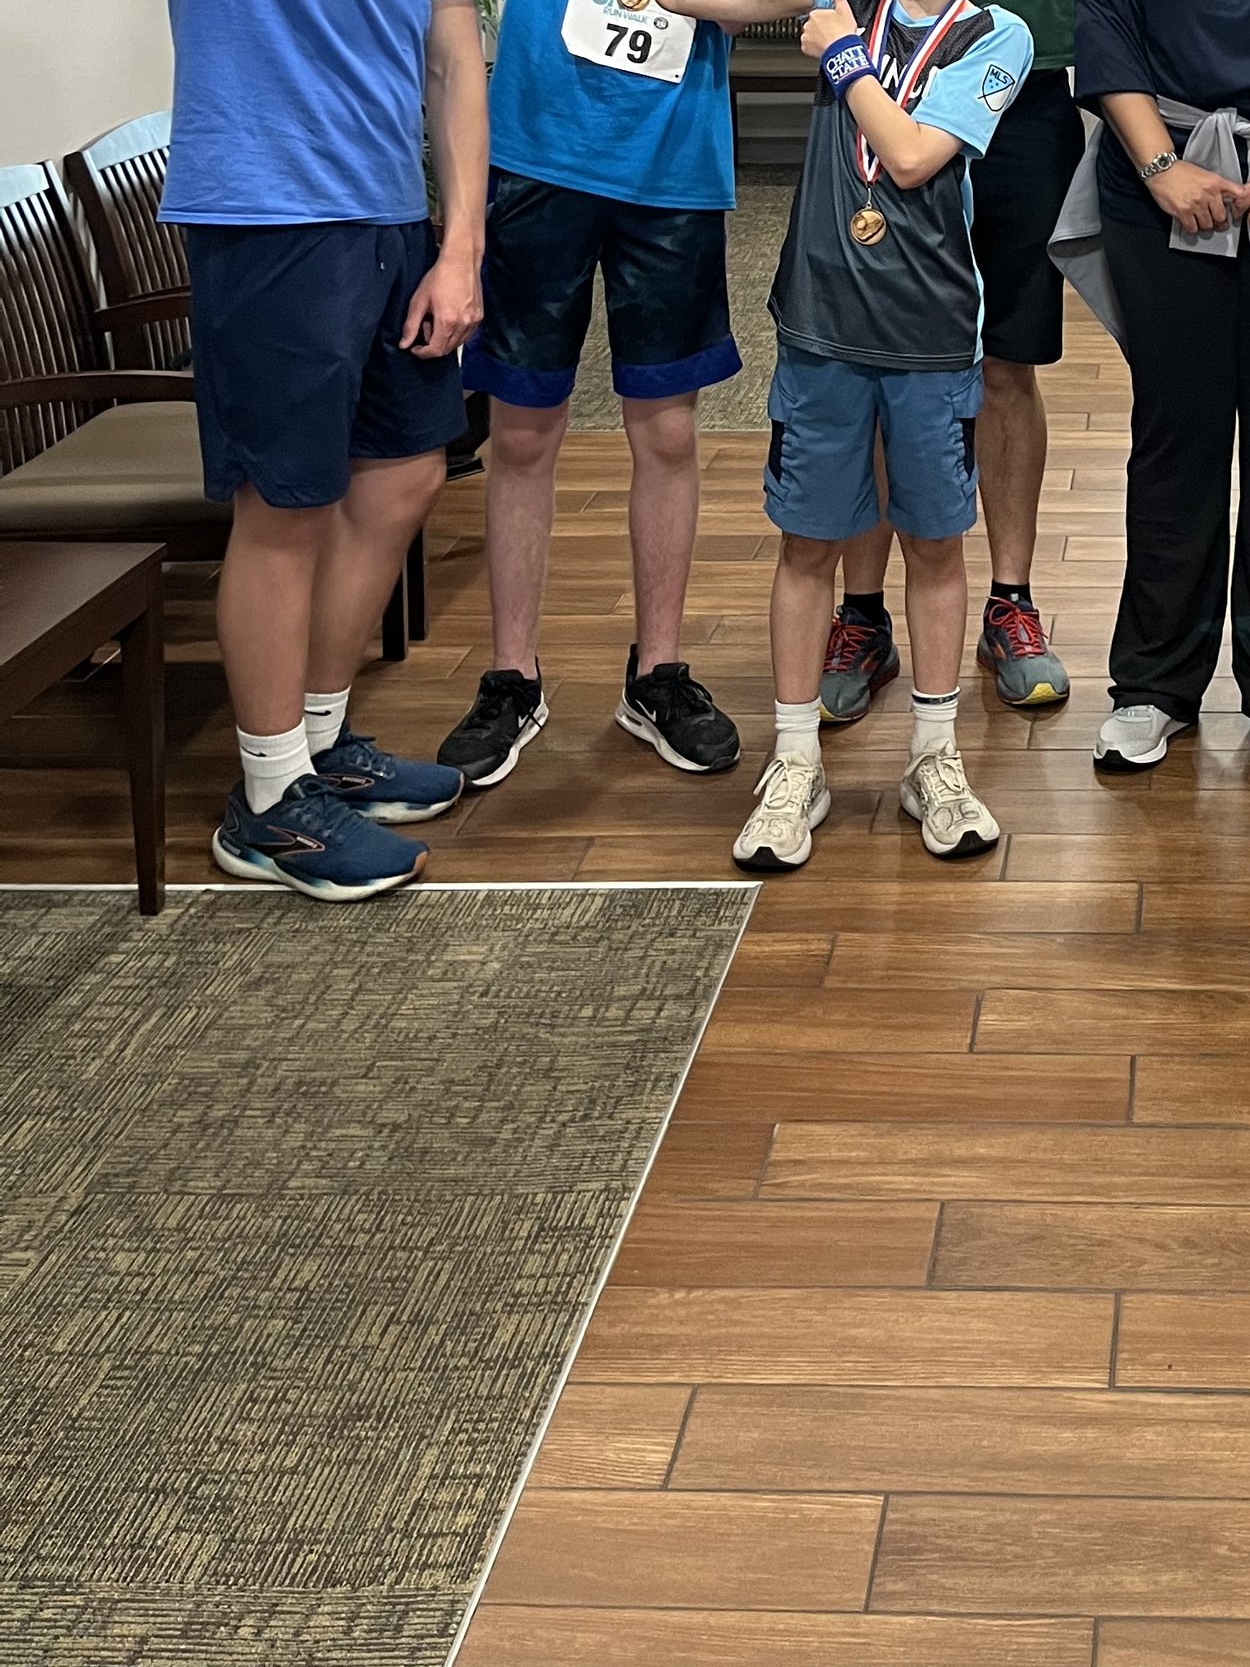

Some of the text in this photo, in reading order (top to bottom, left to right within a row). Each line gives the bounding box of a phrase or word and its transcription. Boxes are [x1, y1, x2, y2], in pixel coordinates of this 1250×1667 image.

[604, 22, 652, 64] 79
[826, 45, 864, 74] CHATT
[831, 56, 870, 85] STATE
[989, 68, 1009, 85] MLS
